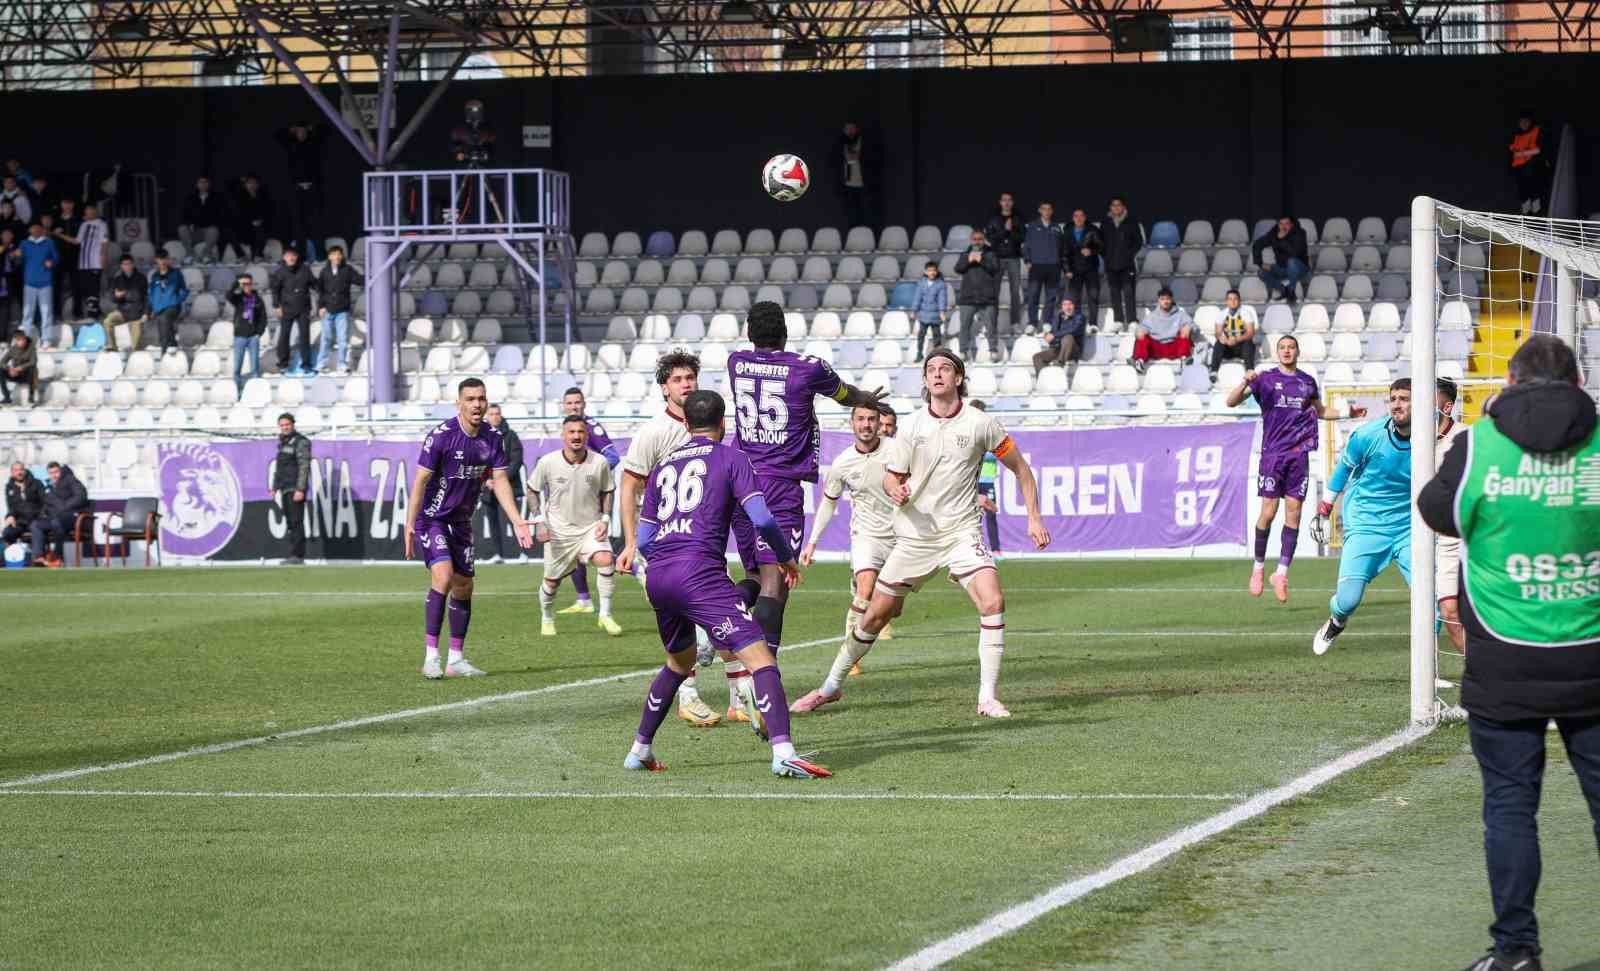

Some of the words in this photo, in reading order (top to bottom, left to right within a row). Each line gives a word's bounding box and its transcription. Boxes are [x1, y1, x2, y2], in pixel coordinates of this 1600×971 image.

[735, 378, 788, 431] 55
[1176, 446, 1223, 483] 19
[656, 459, 707, 521] 36
[1175, 488, 1219, 528] 87
[1520, 577, 1600, 600] PRESS
